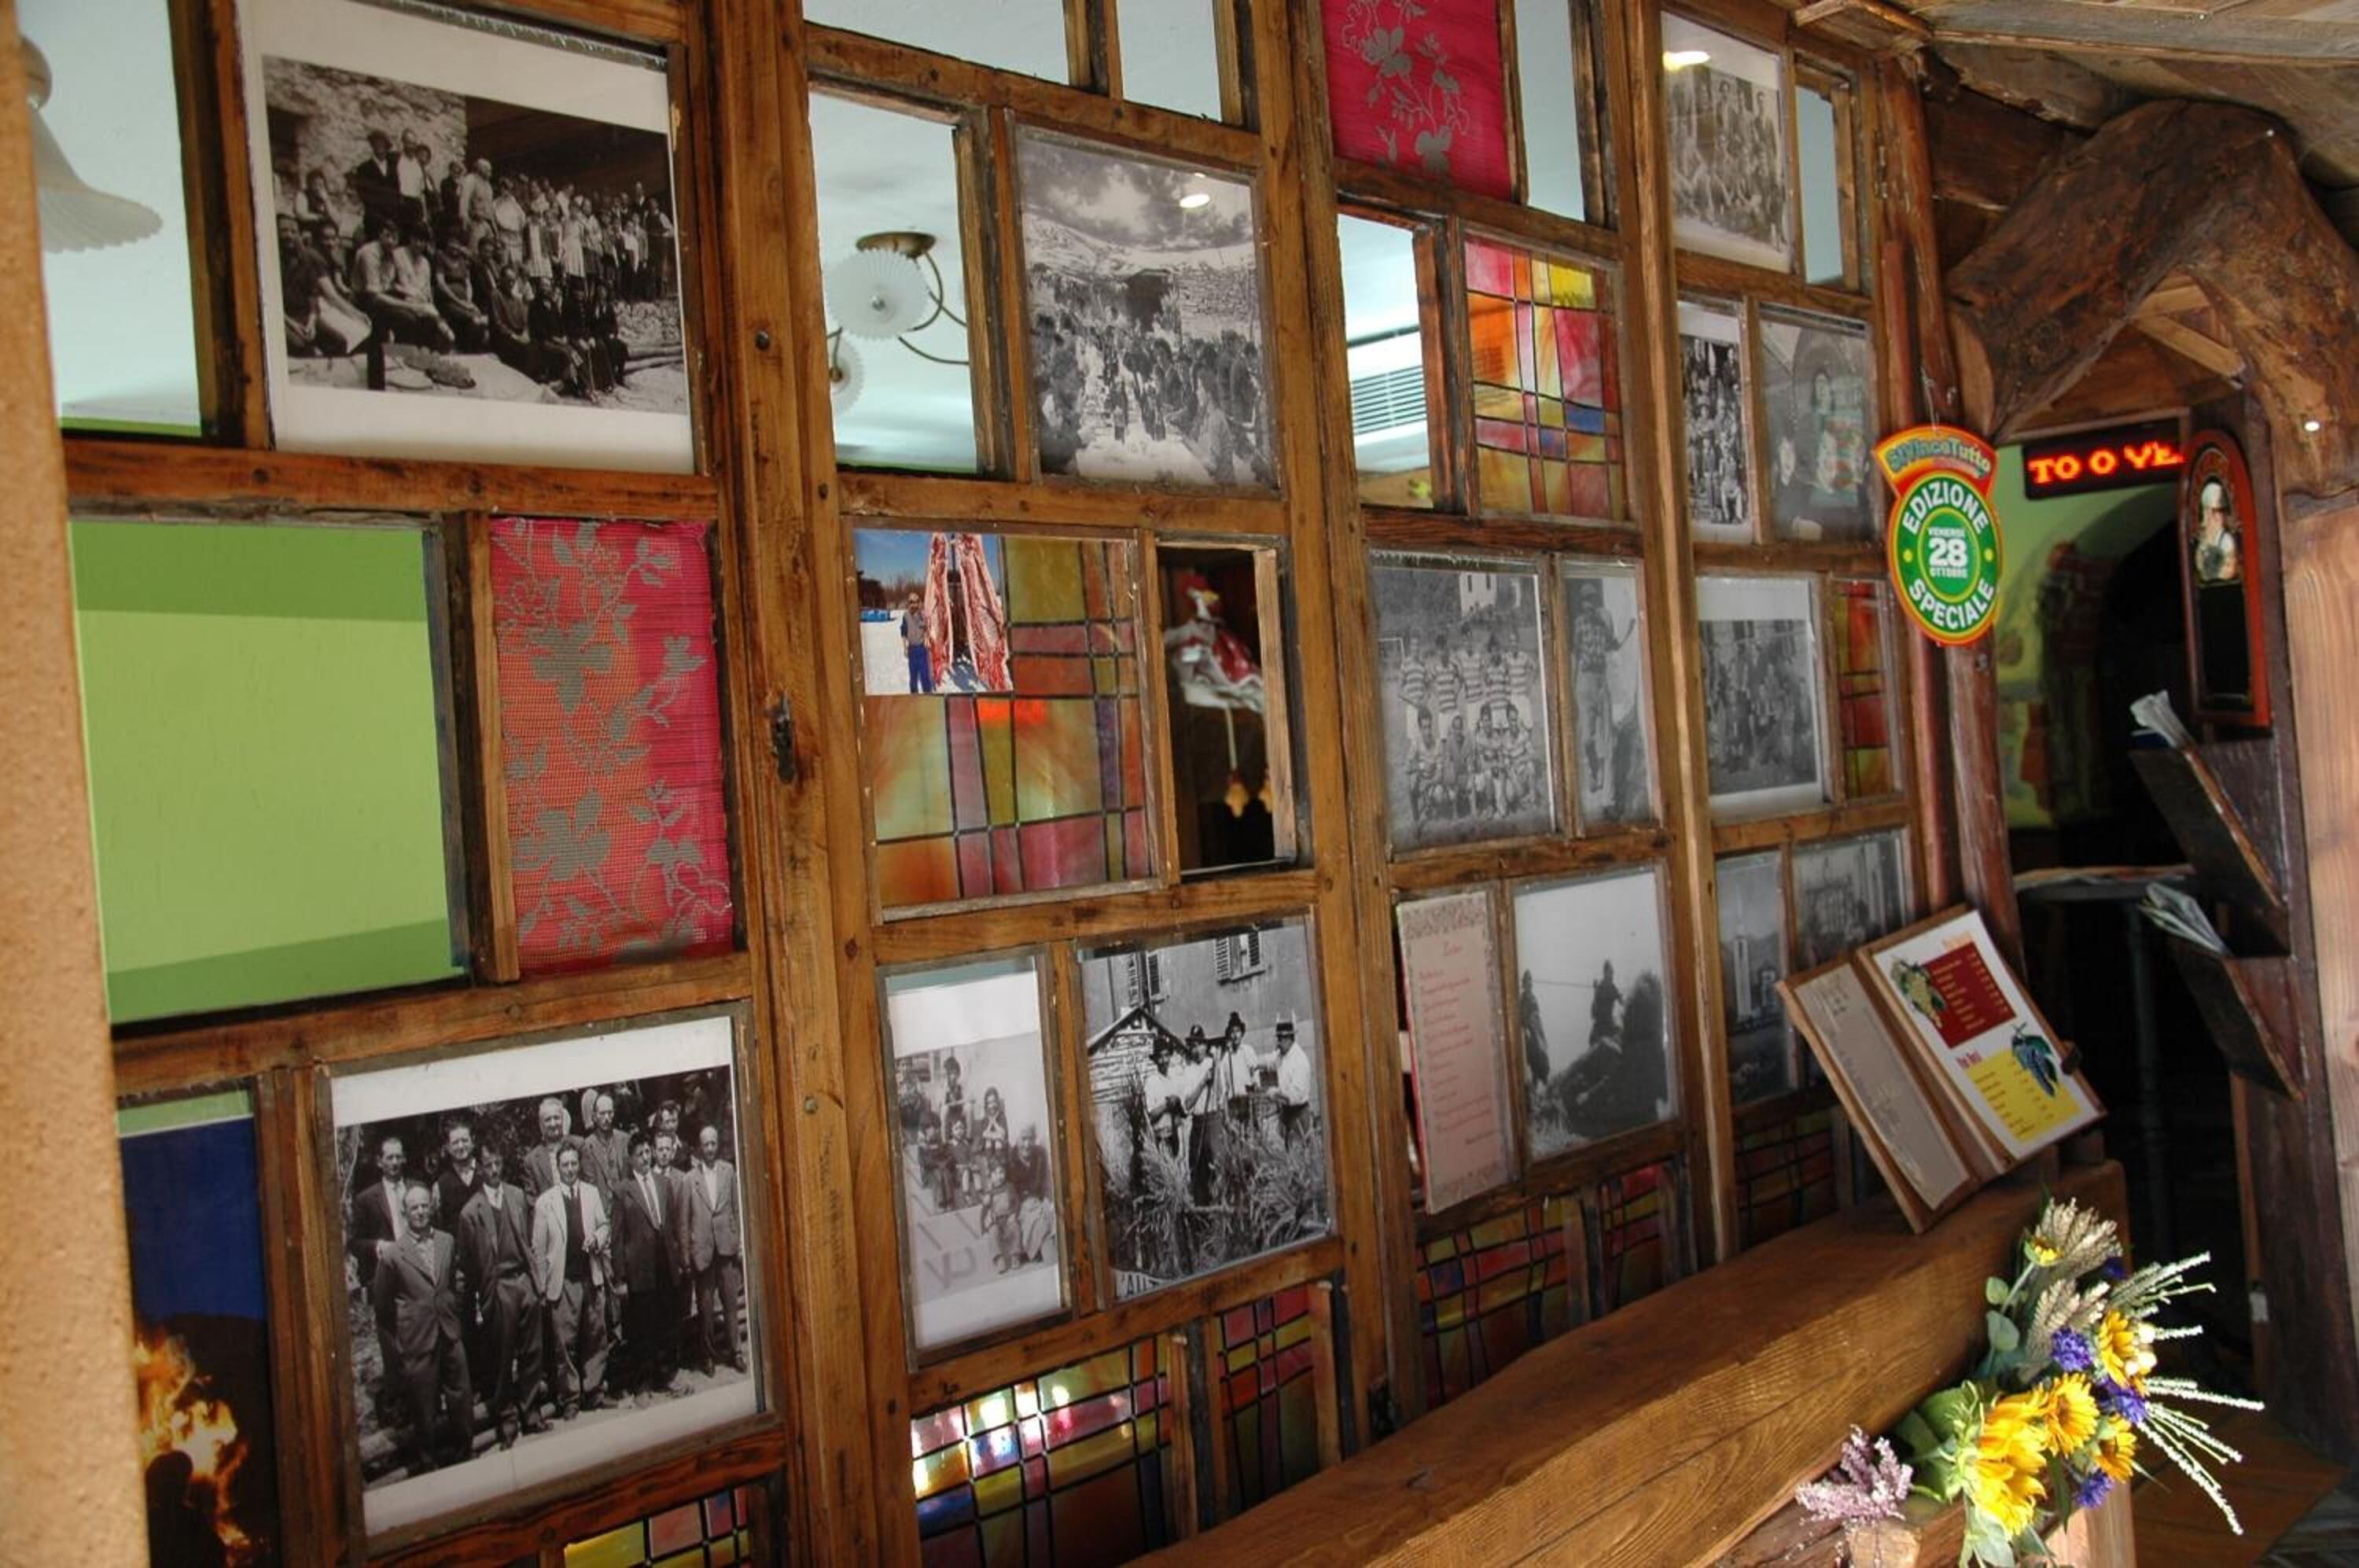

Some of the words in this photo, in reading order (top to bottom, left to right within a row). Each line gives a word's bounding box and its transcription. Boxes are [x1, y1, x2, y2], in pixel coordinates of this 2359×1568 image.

[1902, 480, 1989, 535] EDIZIONE
[1929, 537, 1967, 566] 28
[1909, 578, 1993, 629] SPECIALE
